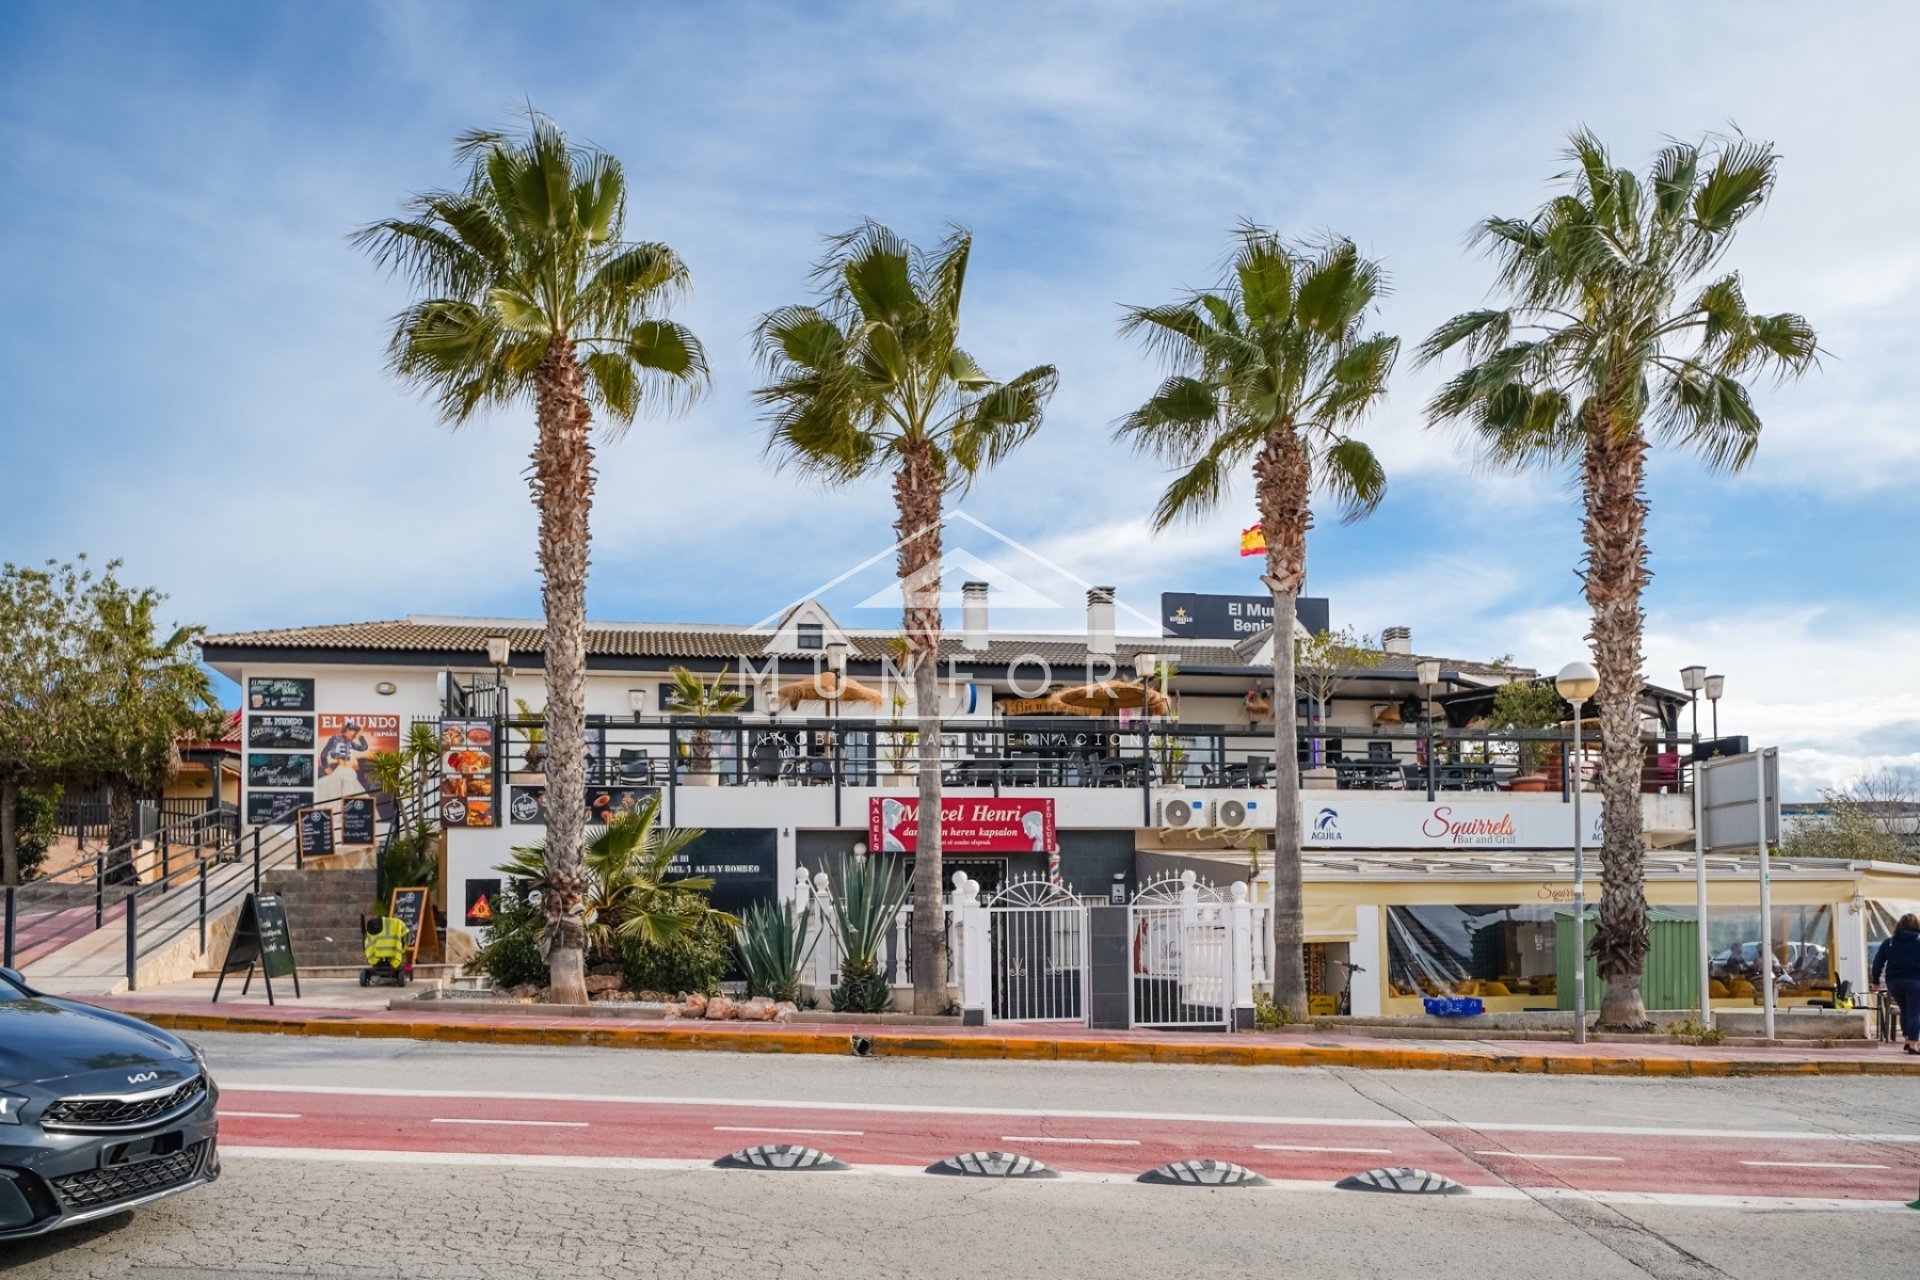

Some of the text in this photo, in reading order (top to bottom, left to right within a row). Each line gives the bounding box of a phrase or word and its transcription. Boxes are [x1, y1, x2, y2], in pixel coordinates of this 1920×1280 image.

[1228, 603, 1241, 616] El
[321, 716, 397, 729] EL MUNDO
[972, 805, 1022, 822] Henri
[872, 798, 880, 850] NAGELS
[1422, 806, 1516, 844] Squirrels
[950, 828, 975, 836] heren
[979, 828, 1018, 838] kapsalon
[1311, 831, 1342, 841] AGUILA
[1458, 835, 1516, 844] Bar and Grill
[695, 865, 707, 873] AL
[725, 864, 760, 873] BOMBEO
